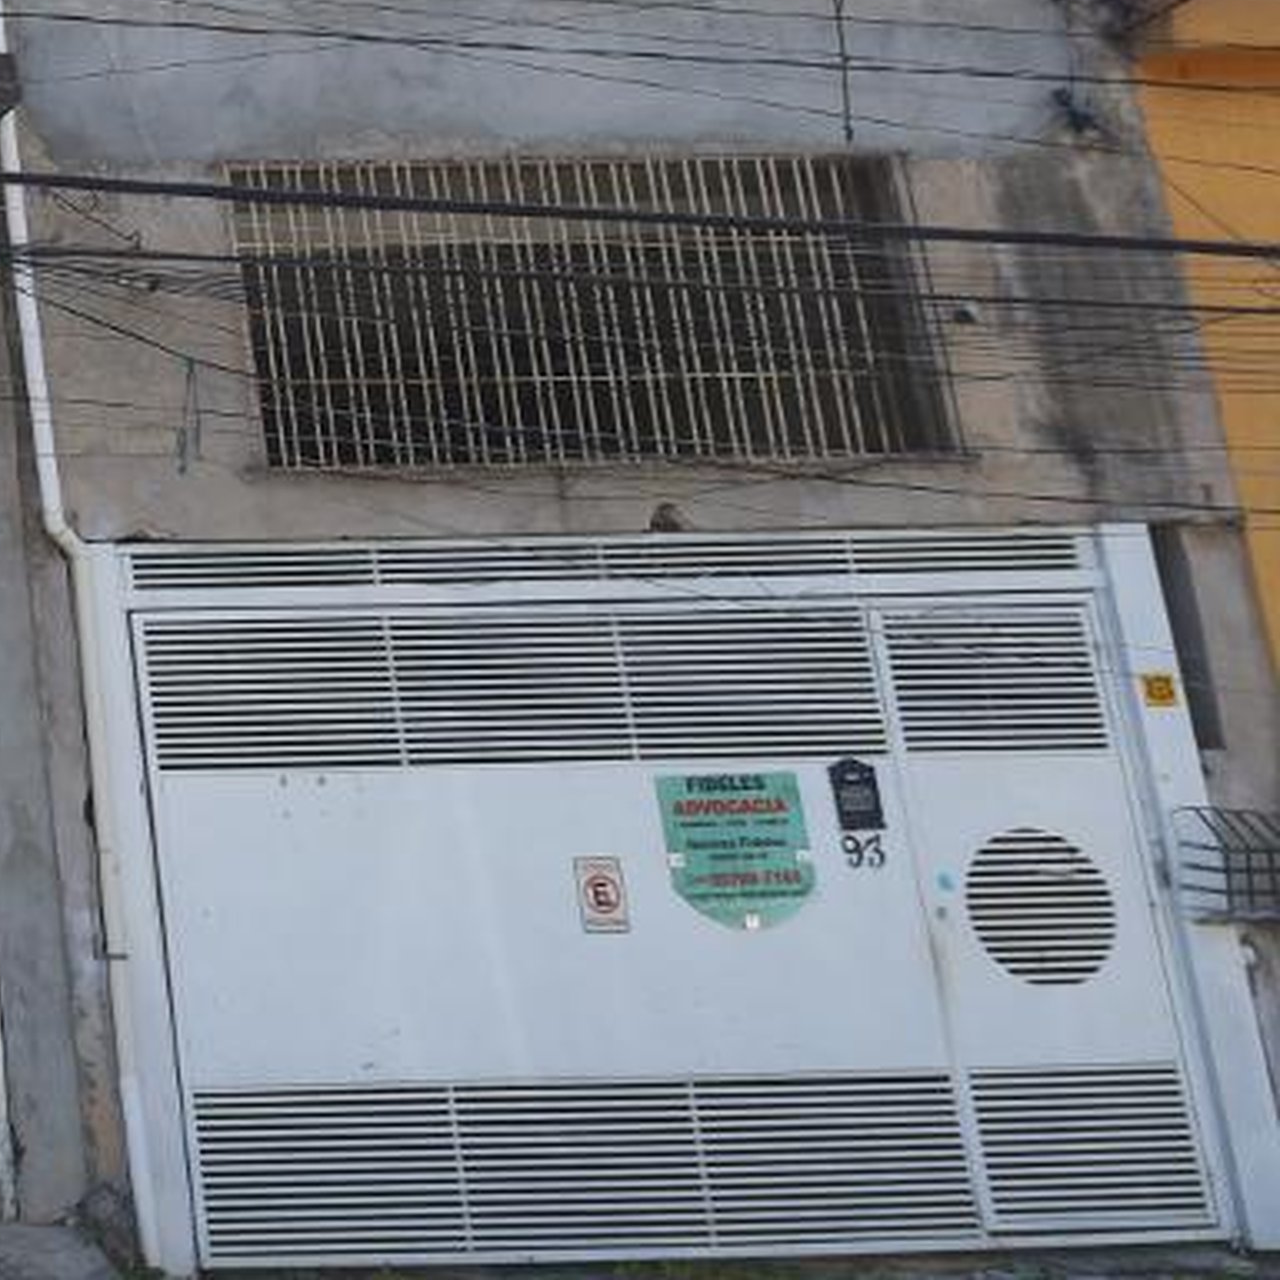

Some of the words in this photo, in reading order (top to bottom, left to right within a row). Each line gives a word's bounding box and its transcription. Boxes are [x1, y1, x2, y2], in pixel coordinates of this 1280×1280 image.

[673, 796, 789, 817] ADVOCACIA
[841, 833, 887, 869] 93
[592, 881, 614, 908] E
